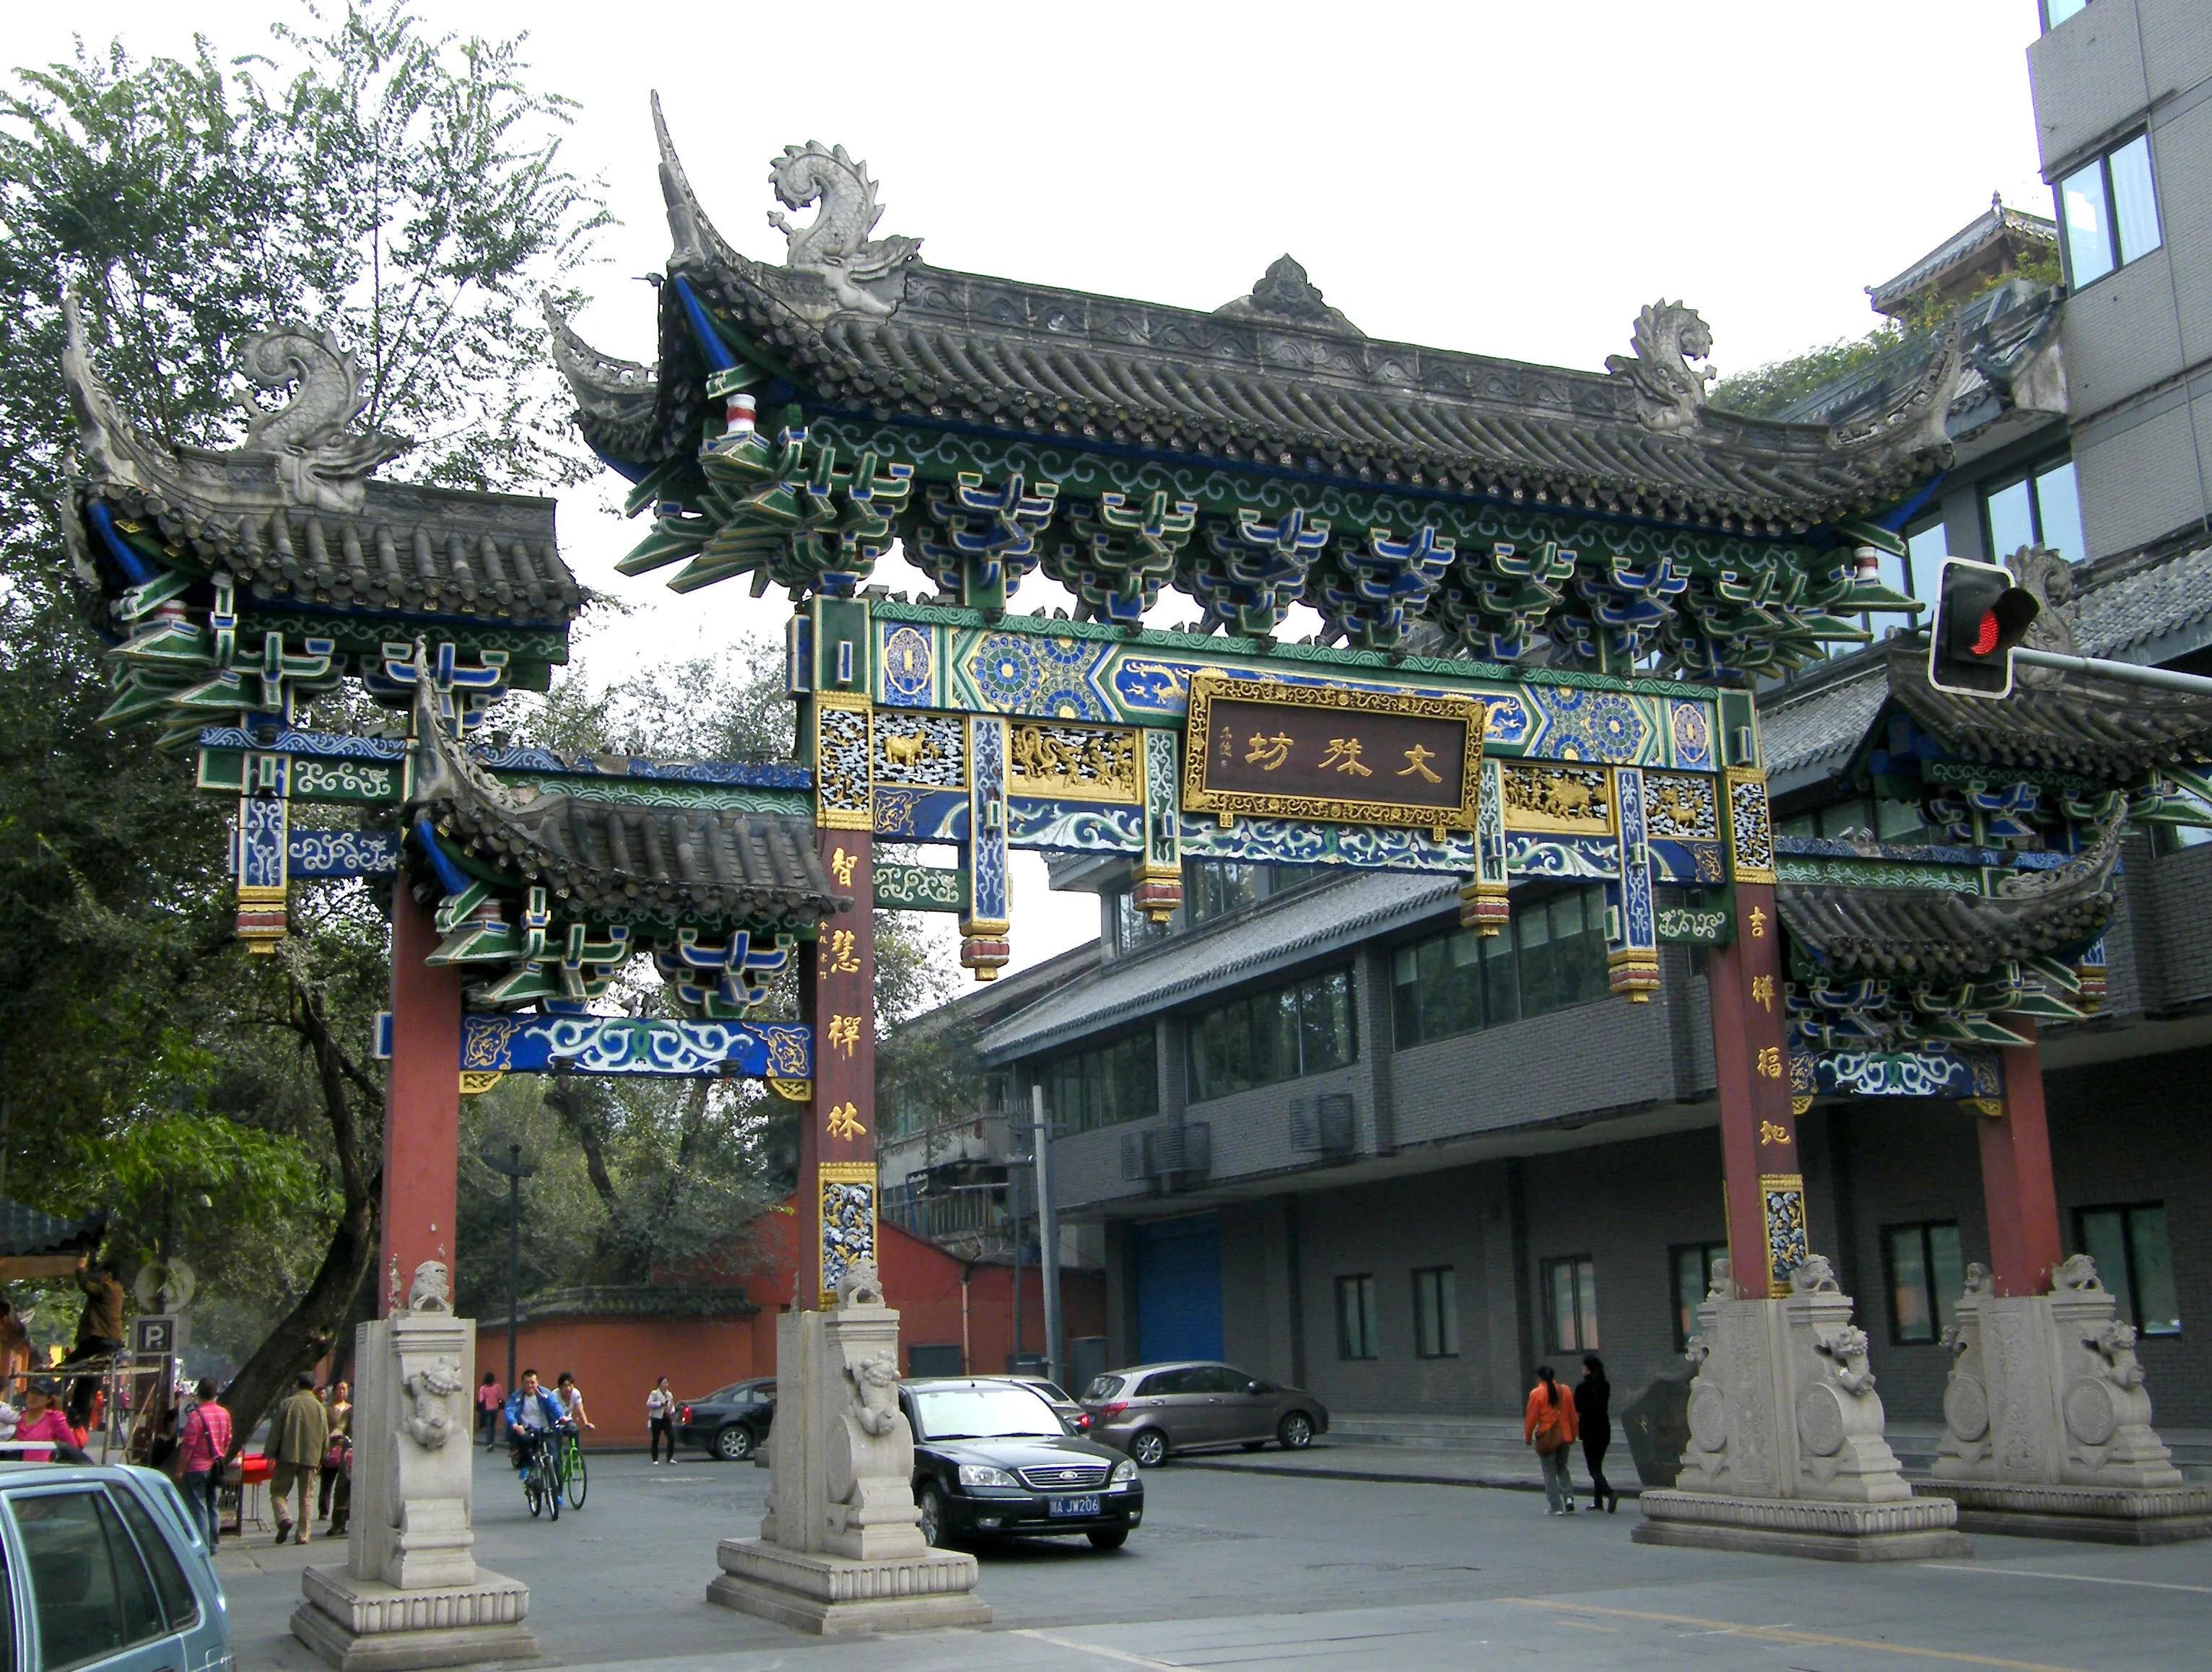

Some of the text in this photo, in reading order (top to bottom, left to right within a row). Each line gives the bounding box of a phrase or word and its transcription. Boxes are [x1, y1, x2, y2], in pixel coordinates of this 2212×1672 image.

[1244, 731, 1443, 784] 文殊坊
[826, 847, 867, 1141] 智慧禪林
[1748, 905, 1792, 1146] 吉祥福地
[145, 1325, 165, 1349] P
